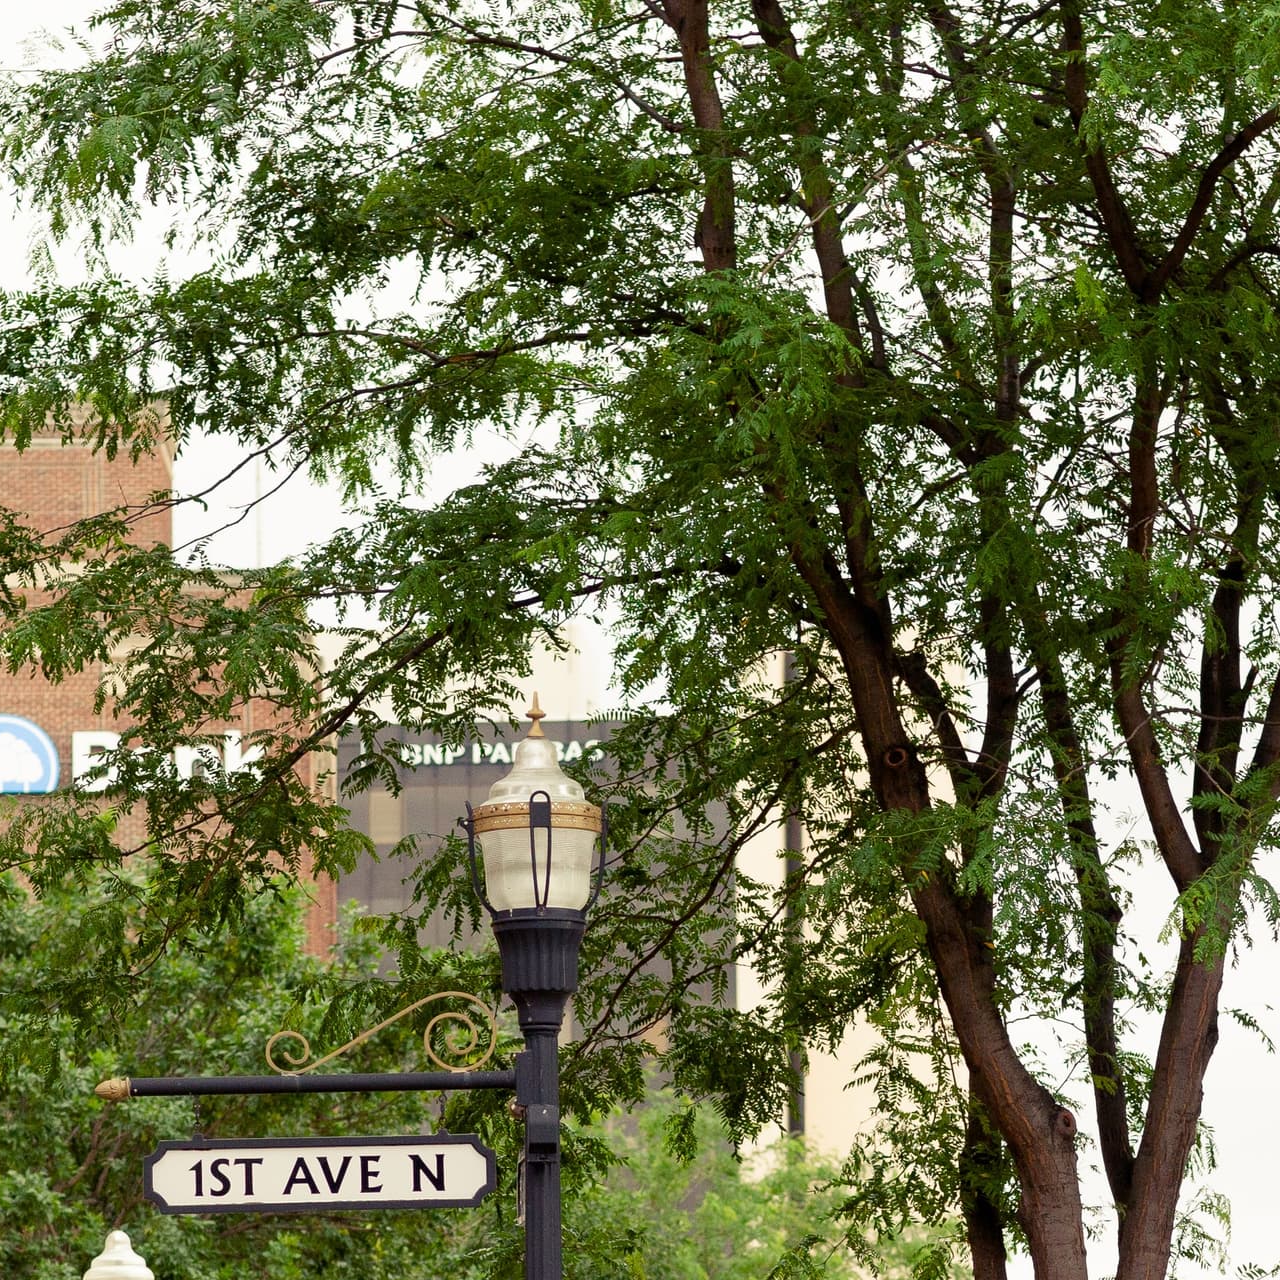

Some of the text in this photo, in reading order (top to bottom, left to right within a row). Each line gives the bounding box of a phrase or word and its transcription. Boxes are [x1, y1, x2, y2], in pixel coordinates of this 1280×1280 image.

[400, 739, 606, 766] BNP PABAS
[188, 1153, 446, 1197] 1ST AVE N
